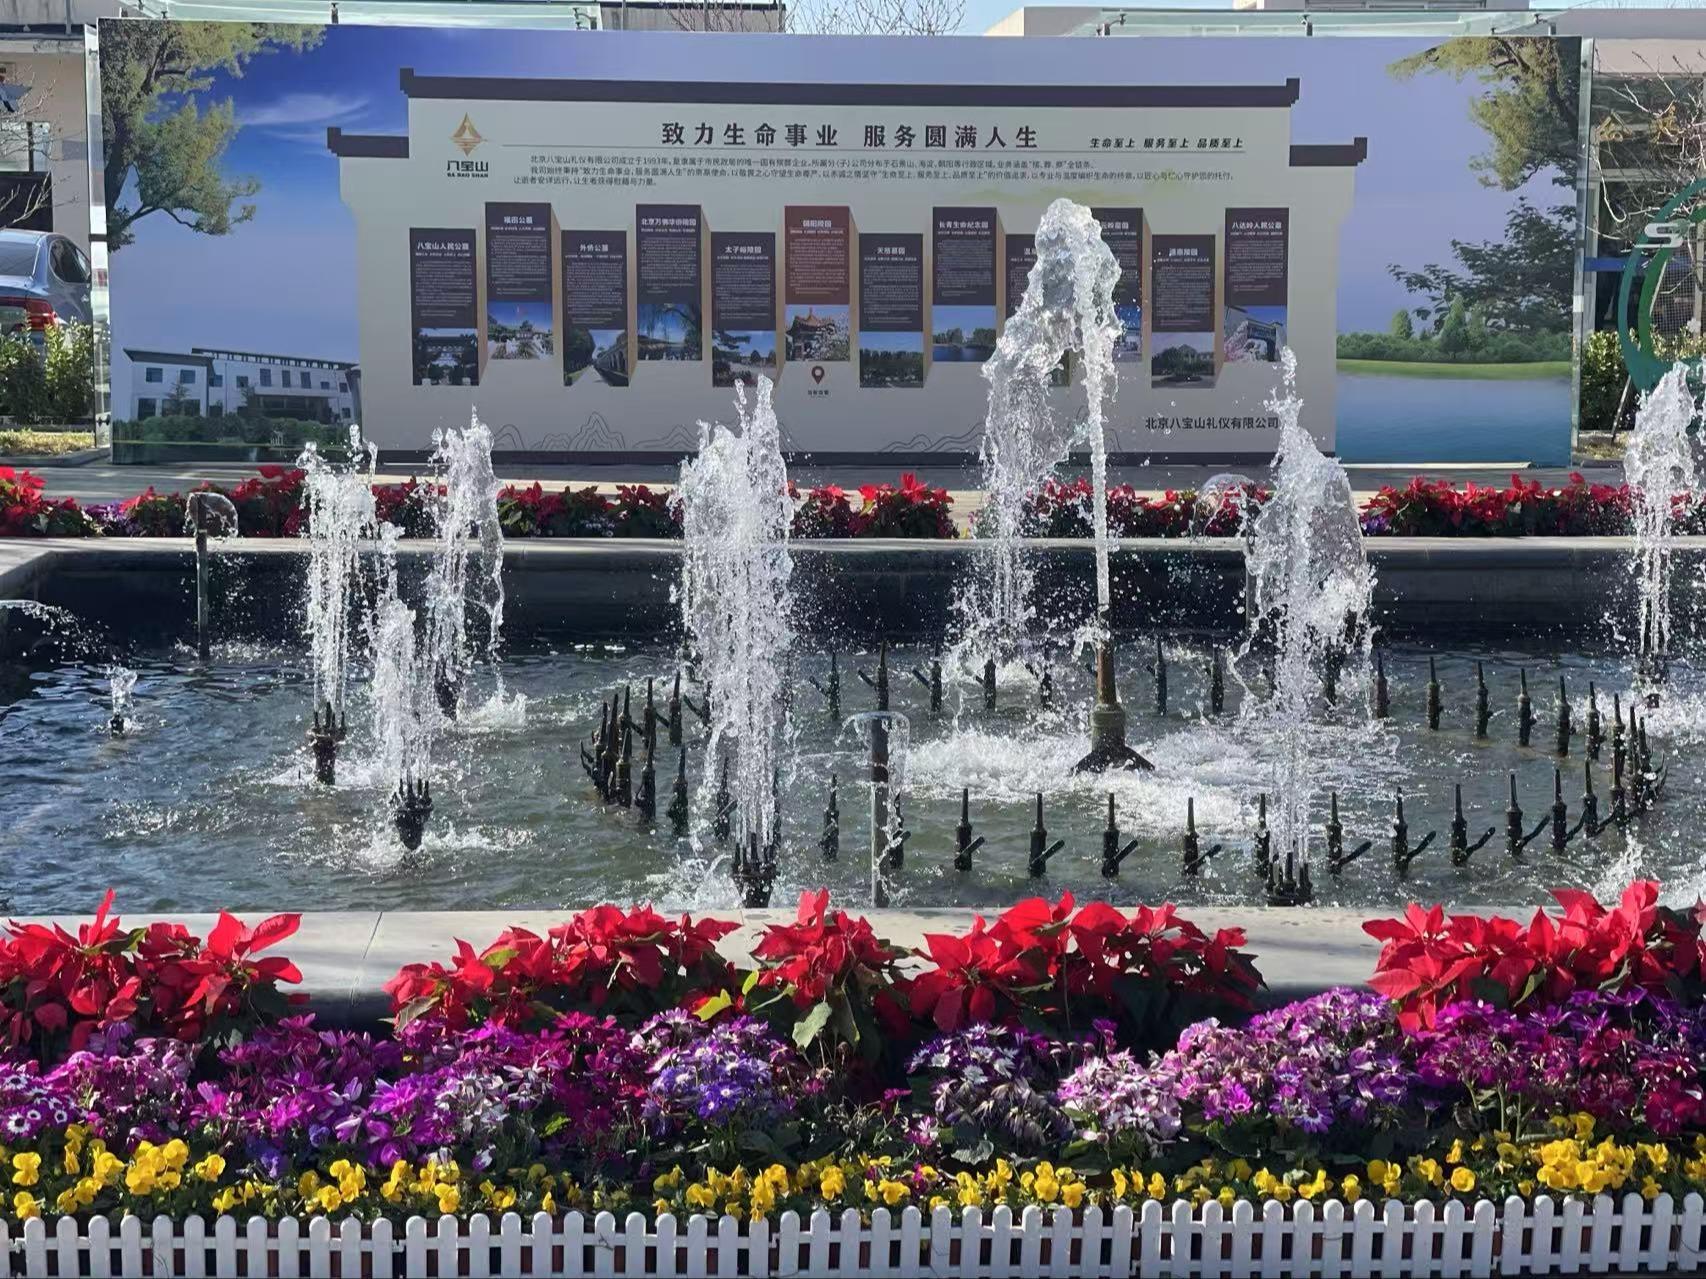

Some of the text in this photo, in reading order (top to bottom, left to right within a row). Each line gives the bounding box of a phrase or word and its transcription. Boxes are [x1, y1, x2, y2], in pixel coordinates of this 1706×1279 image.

[662, 122, 1038, 149] 致力生命事业 服务圆满人生
[1090, 138, 1243, 148] 生命至上 服务至上 品质至上
[447, 161, 488, 171] 八宝山
[417, 243, 470, 251] 八宝山人民公墓
[1145, 417, 1279, 430] 北京八宝山礼仪有限公司
